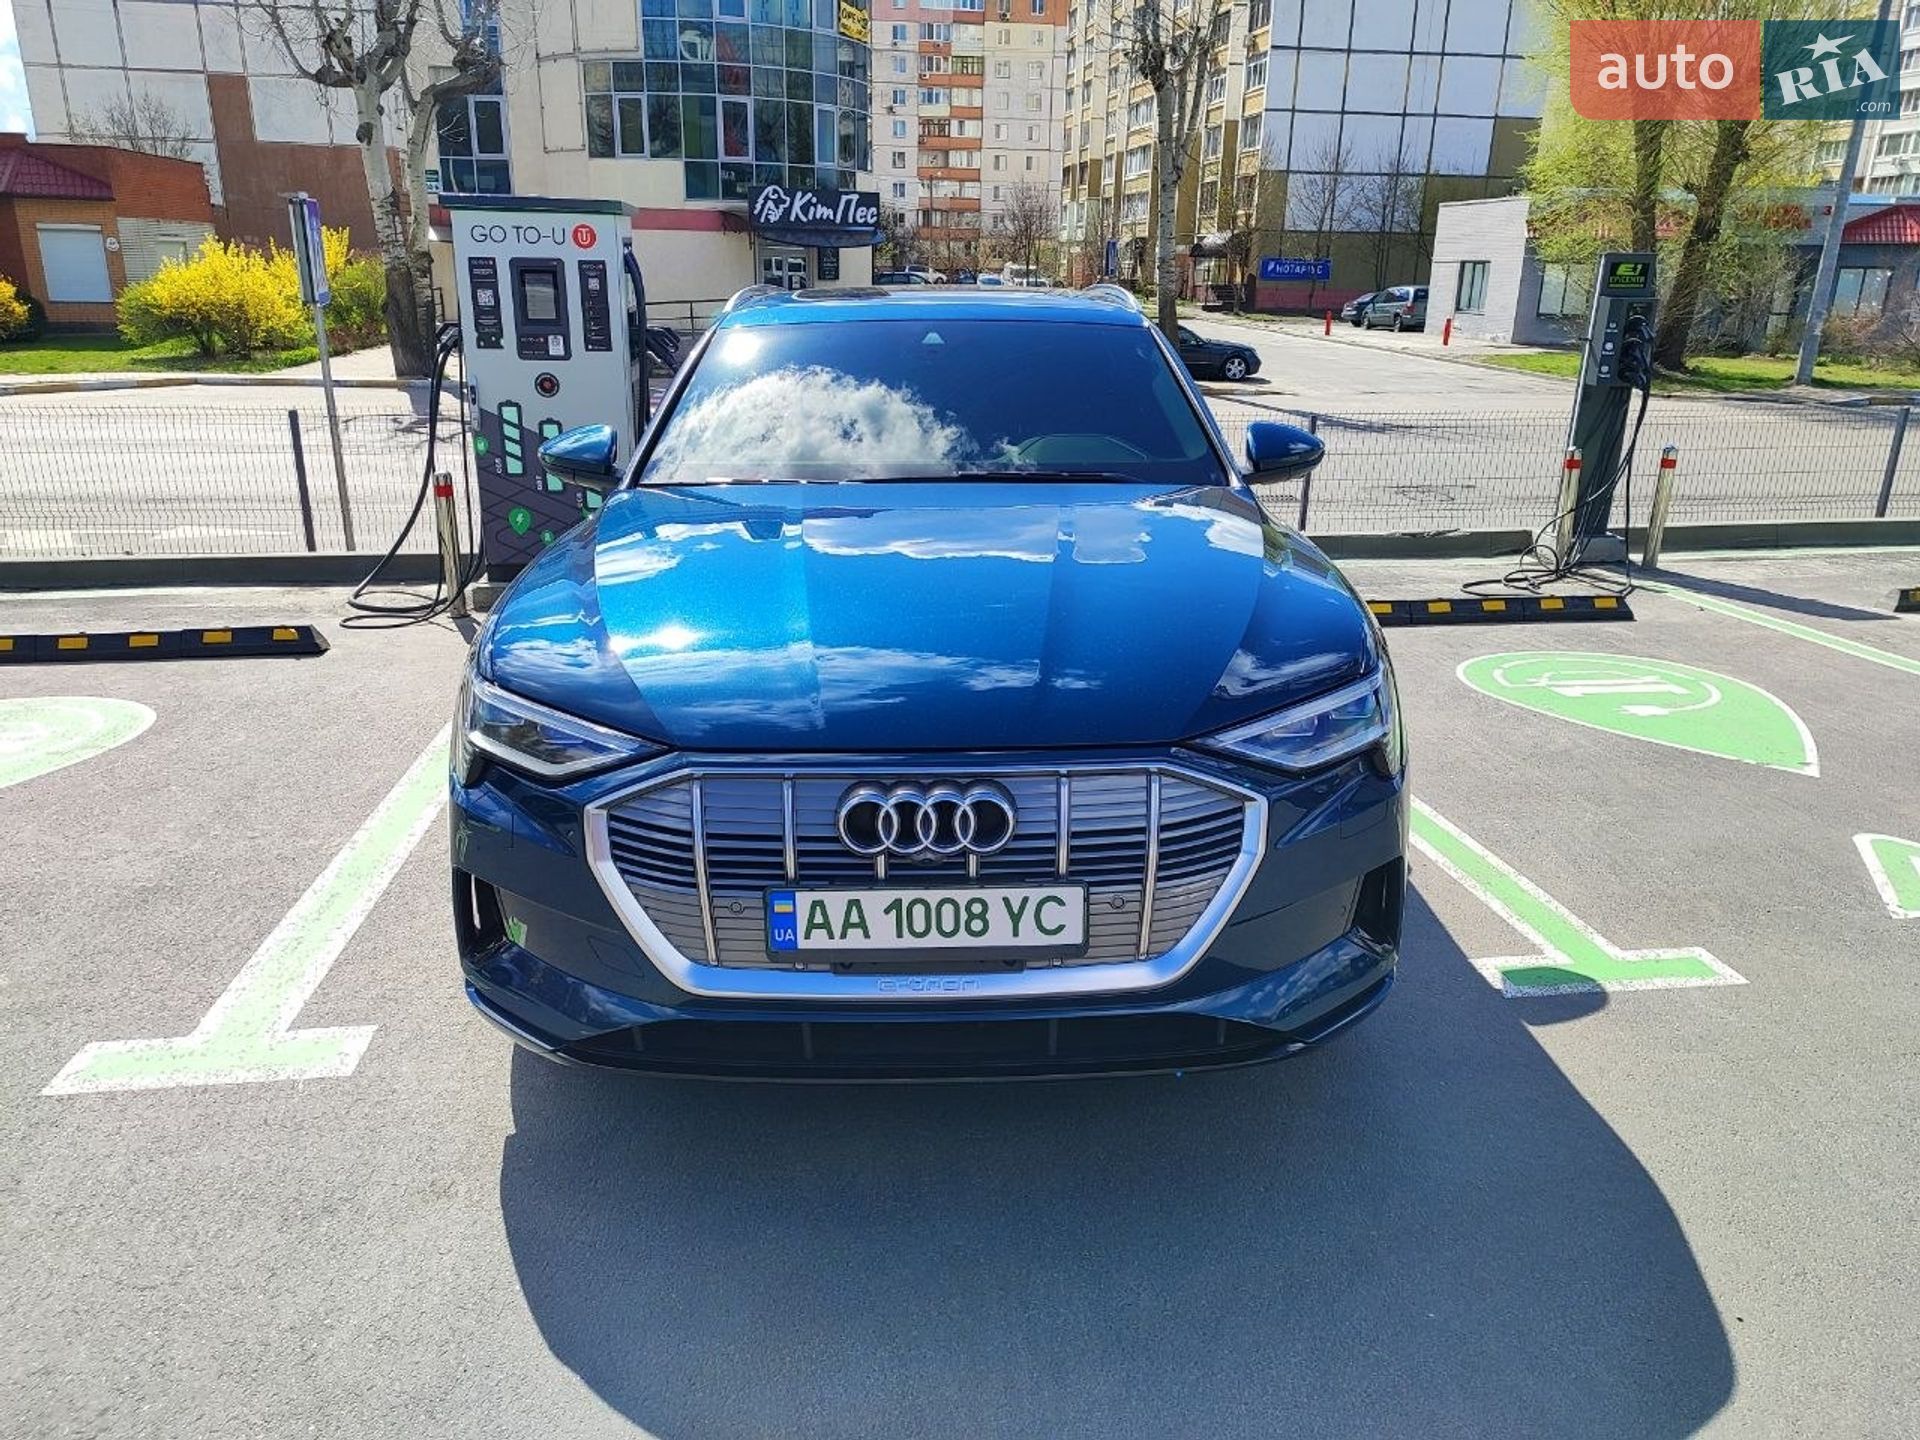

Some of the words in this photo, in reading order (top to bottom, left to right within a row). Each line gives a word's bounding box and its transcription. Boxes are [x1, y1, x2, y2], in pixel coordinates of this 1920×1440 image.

[470, 225, 507, 244] GO
[512, 225, 566, 246] TO-U
[804, 898, 871, 940] AA
[883, 896, 990, 939] 1008
[1001, 895, 1067, 938] YC
[775, 929, 796, 941] UA
